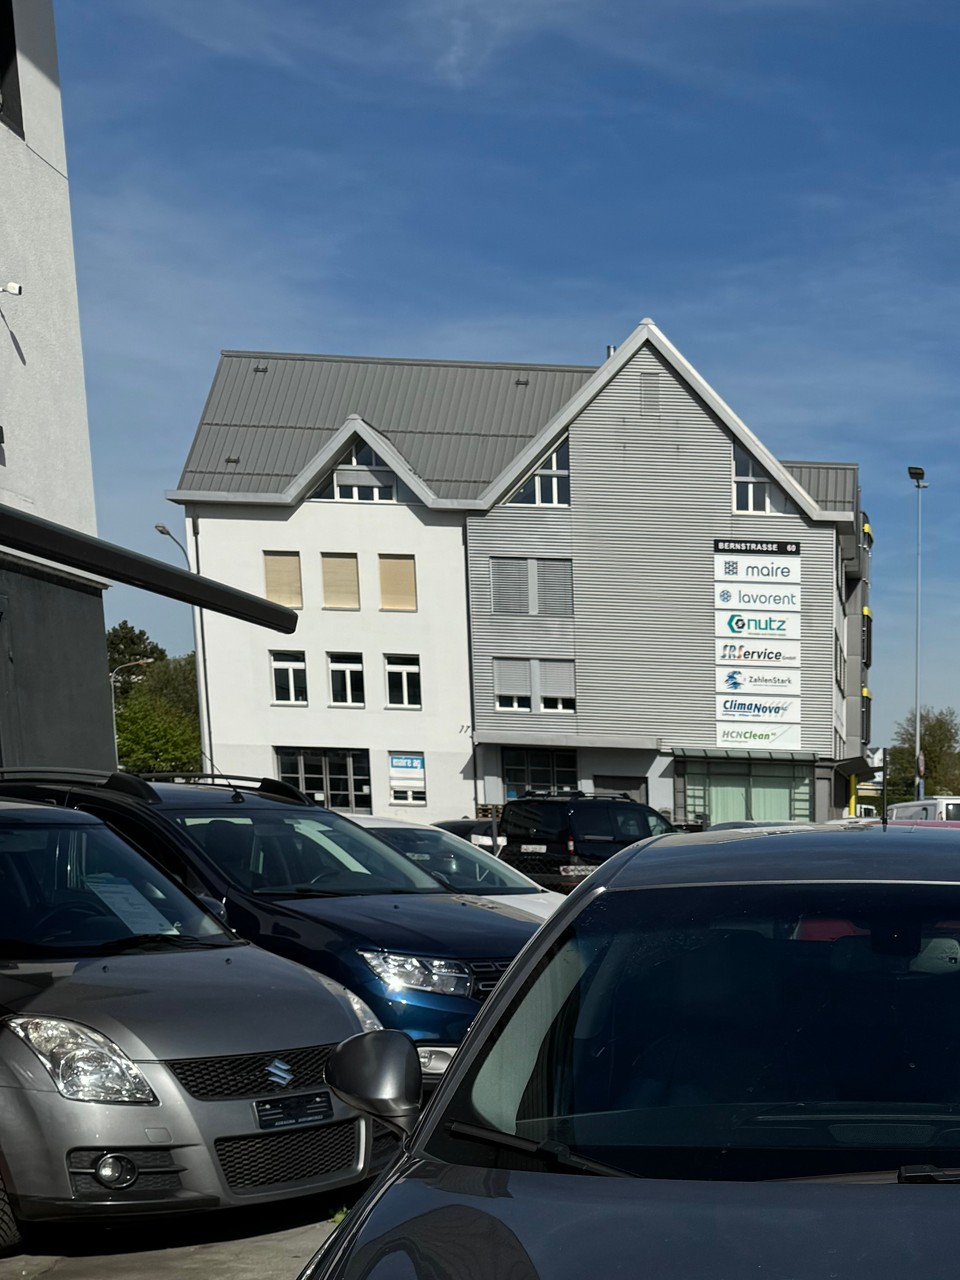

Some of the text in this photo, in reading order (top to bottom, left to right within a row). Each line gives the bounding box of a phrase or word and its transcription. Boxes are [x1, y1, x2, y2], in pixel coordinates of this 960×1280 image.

[718, 542, 797, 552] BERNSTRASSE 60
[746, 562, 791, 577] maire
[738, 590, 797, 605] lavorent
[747, 617, 786, 631] nutz
[749, 676, 792, 684] ZahlenStark
[723, 700, 780, 714] ClimaNova
[722, 731, 770, 740] HCNClean
